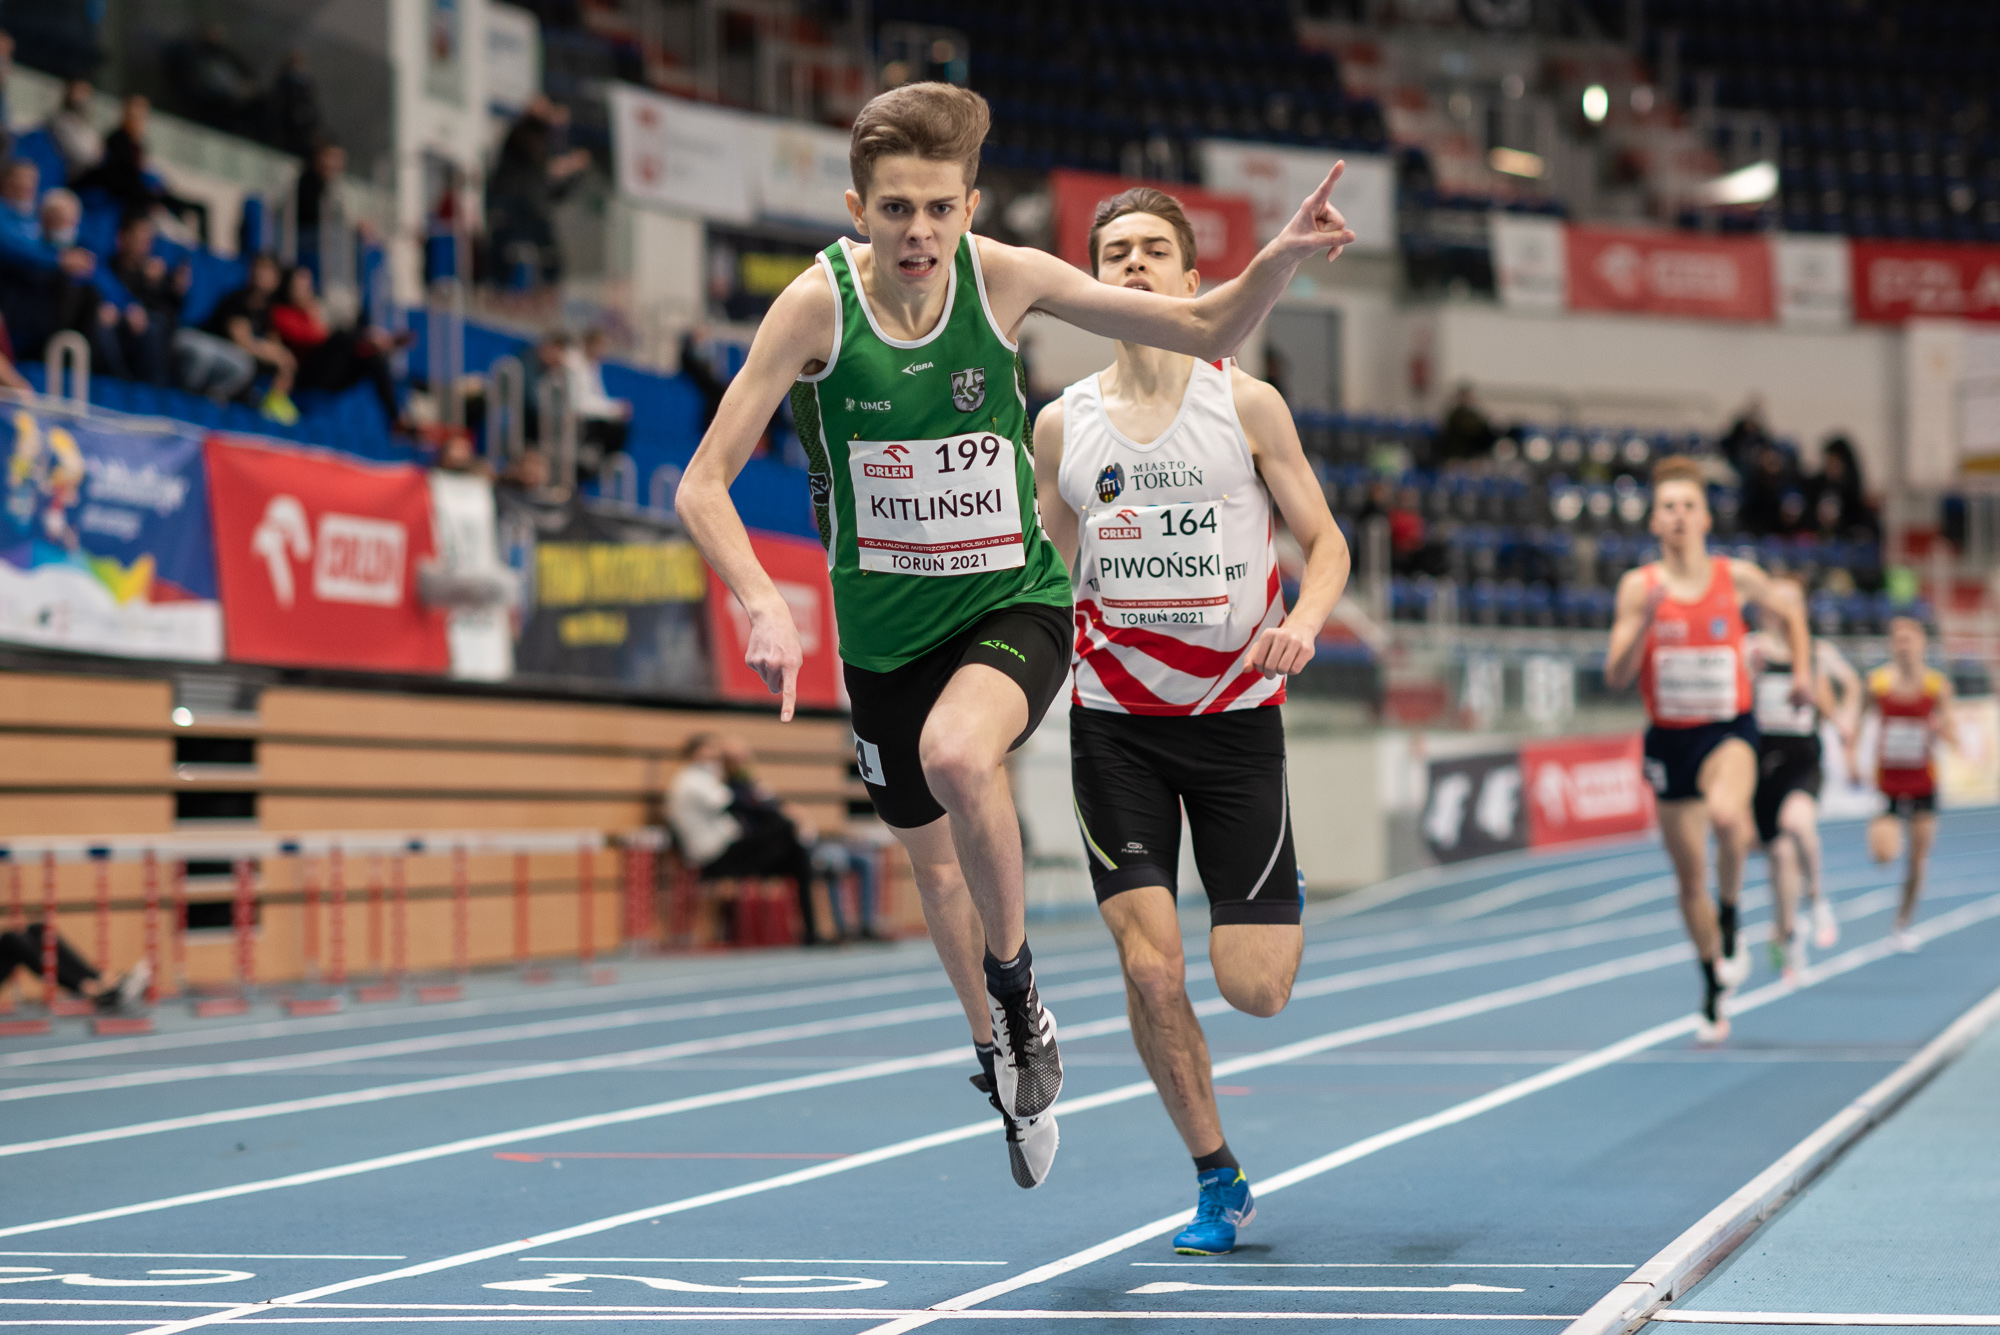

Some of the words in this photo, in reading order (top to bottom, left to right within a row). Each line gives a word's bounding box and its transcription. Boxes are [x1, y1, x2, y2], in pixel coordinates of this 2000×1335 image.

[859, 400, 892, 411] UMCS
[935, 435, 1000, 474] 199
[865, 465, 911, 478] ORLEN
[1133, 460, 1186, 474] MIASTO
[1130, 466, 1204, 491] TORUŃ
[870, 488, 1002, 522] KITLIŃSKI
[1159, 506, 1217, 537] 164
[1100, 528, 1139, 539] ORLEN
[882, 542, 910, 550] HALOWE
[910, 543, 961, 552] MISTRZOSTWA
[961, 540, 986, 549] POLSKI
[891, 554, 945, 572] TORUŃ
[950, 553, 987, 571] 2021
[1099, 551, 1221, 579] PIWOŃSKI
[1120, 610, 1168, 625] TORUŃ
[1171, 612, 1204, 624] 2021
